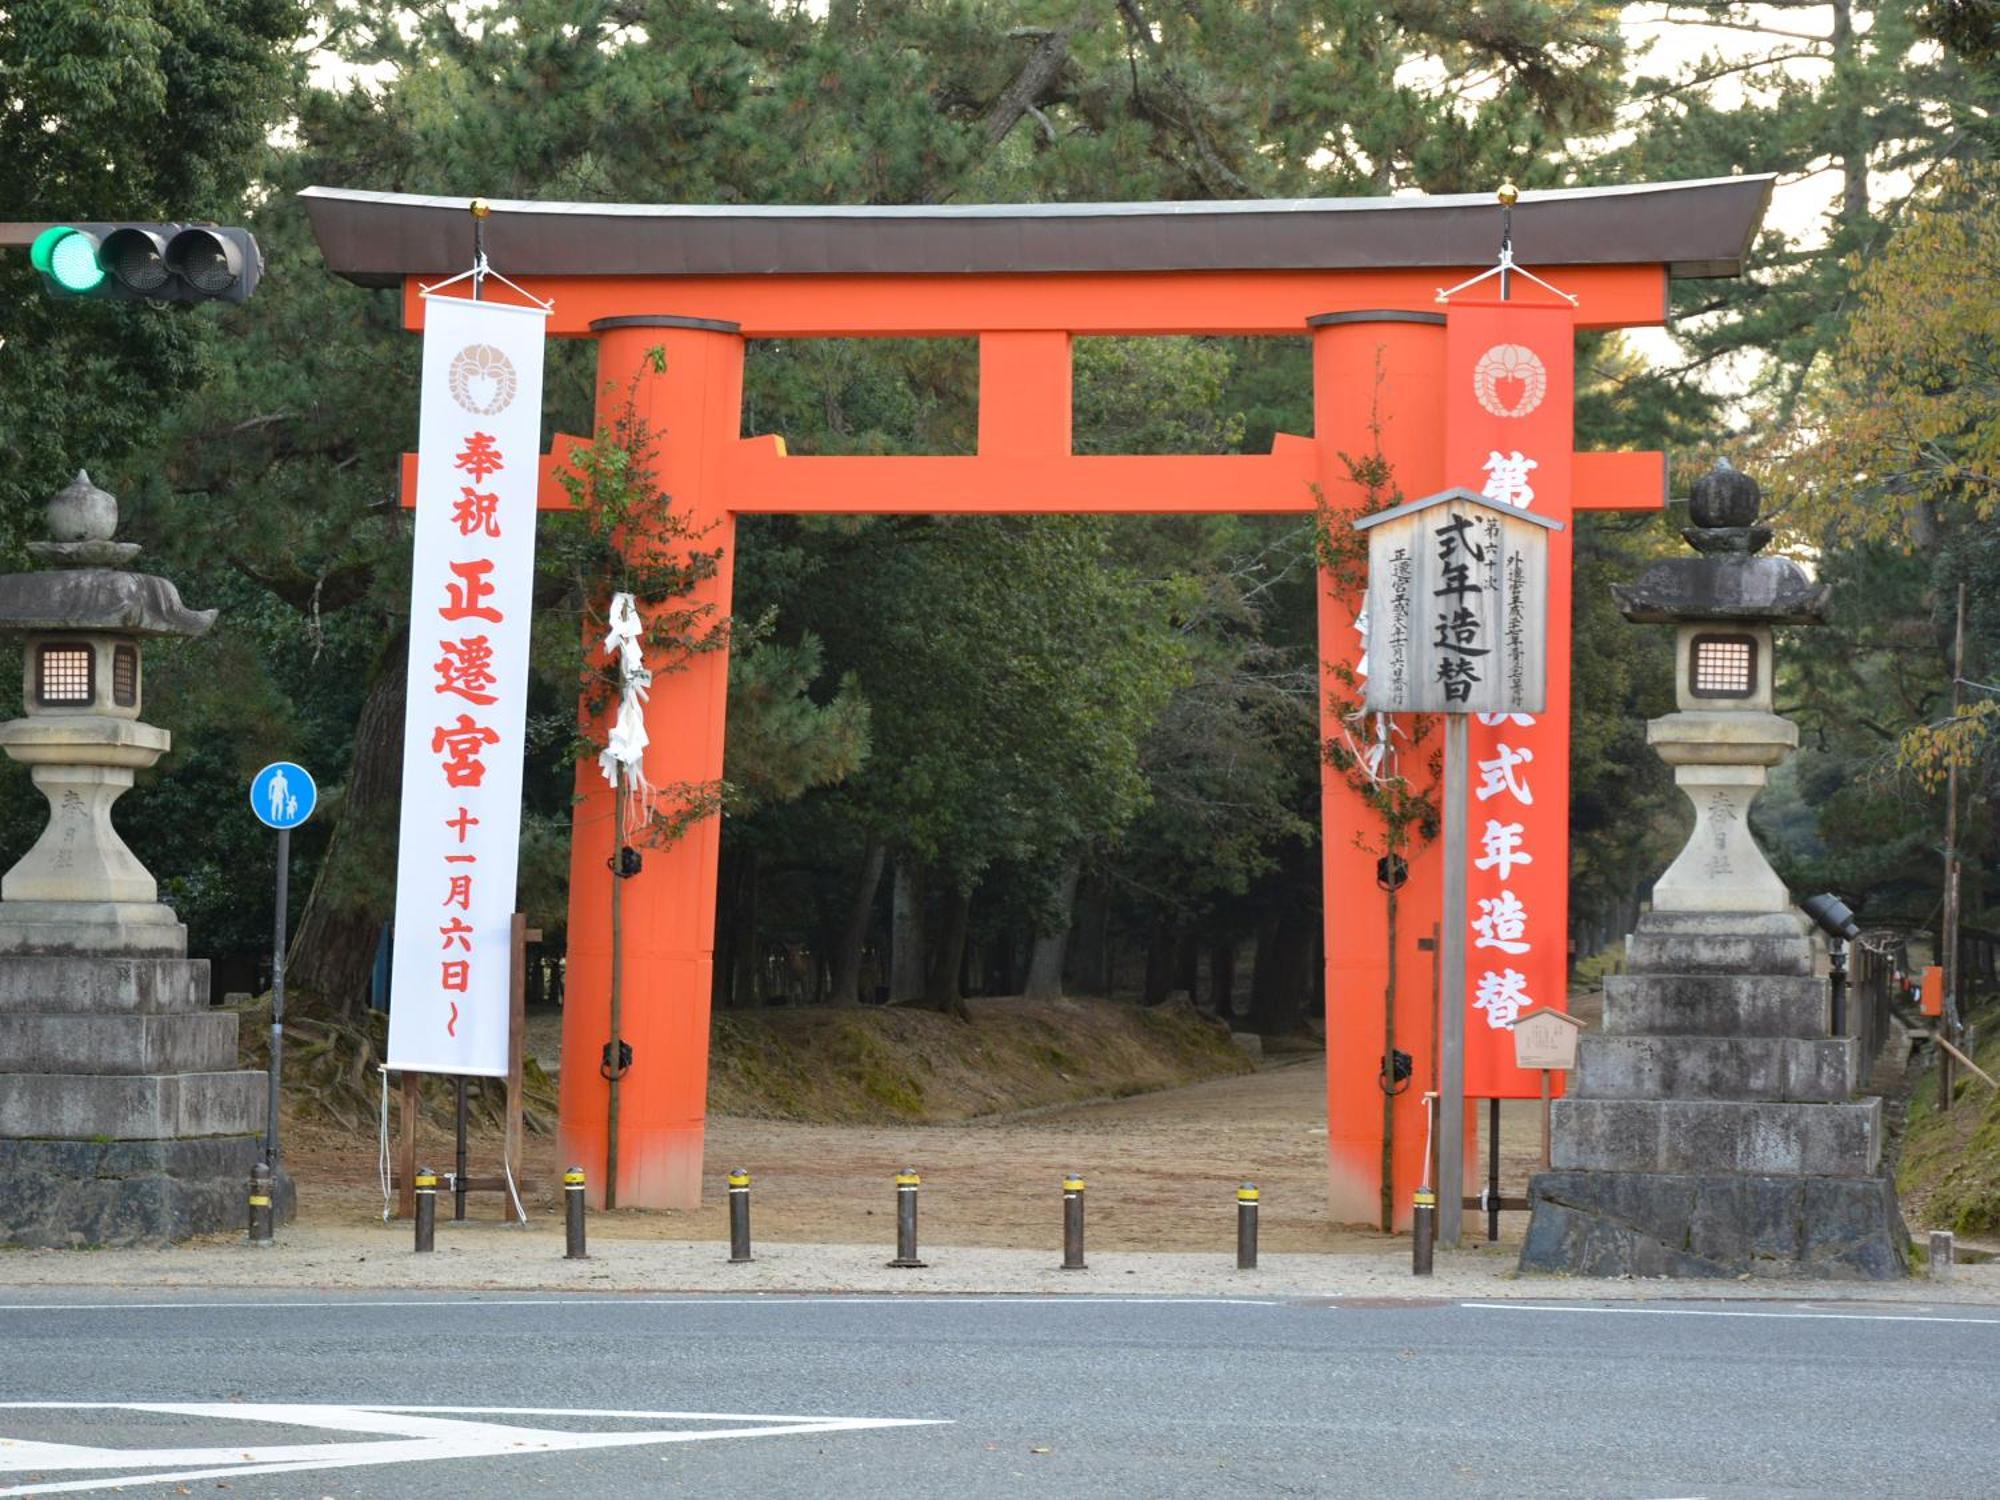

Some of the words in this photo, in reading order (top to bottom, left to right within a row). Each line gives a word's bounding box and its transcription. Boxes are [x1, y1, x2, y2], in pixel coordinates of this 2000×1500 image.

[450, 432, 505, 538] 奉祝
[1433, 513, 1492, 704] 式年造替
[1482, 518, 1500, 593] 第六十次
[431, 558, 504, 788] 正遷宮
[1703, 790, 1738, 880] 春日社
